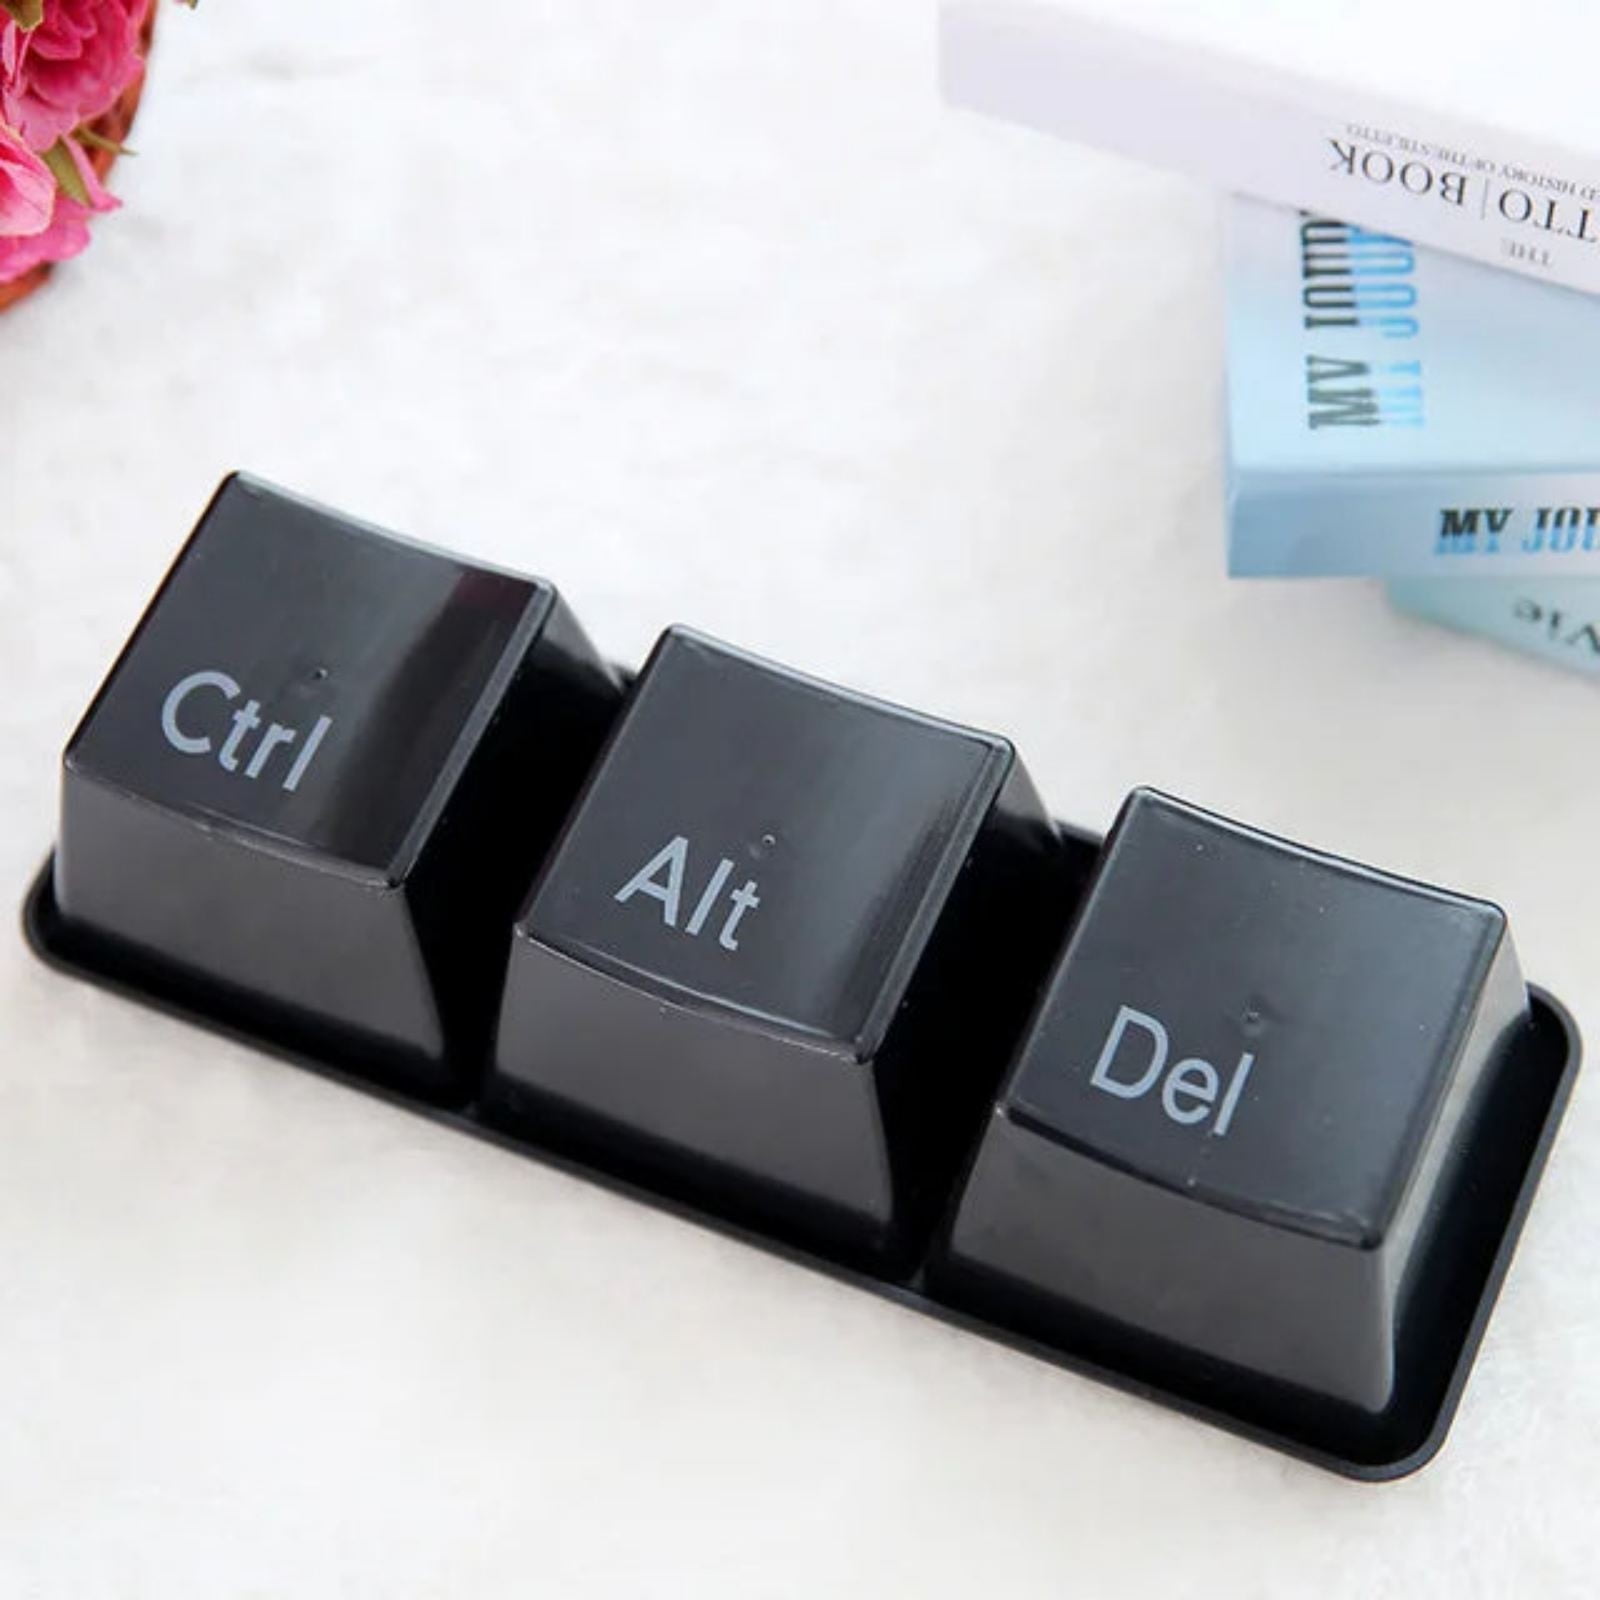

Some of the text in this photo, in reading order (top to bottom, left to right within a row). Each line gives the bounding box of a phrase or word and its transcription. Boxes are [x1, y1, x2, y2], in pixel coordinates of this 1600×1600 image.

[1328, 138, 1468, 206] BOOK
[1306, 354, 1425, 431] MY
[1434, 507, 1514, 555] MY
[162, 671, 333, 792] Ctrl
[613, 834, 760, 951] Alt
[1090, 1004, 1255, 1137] Del
